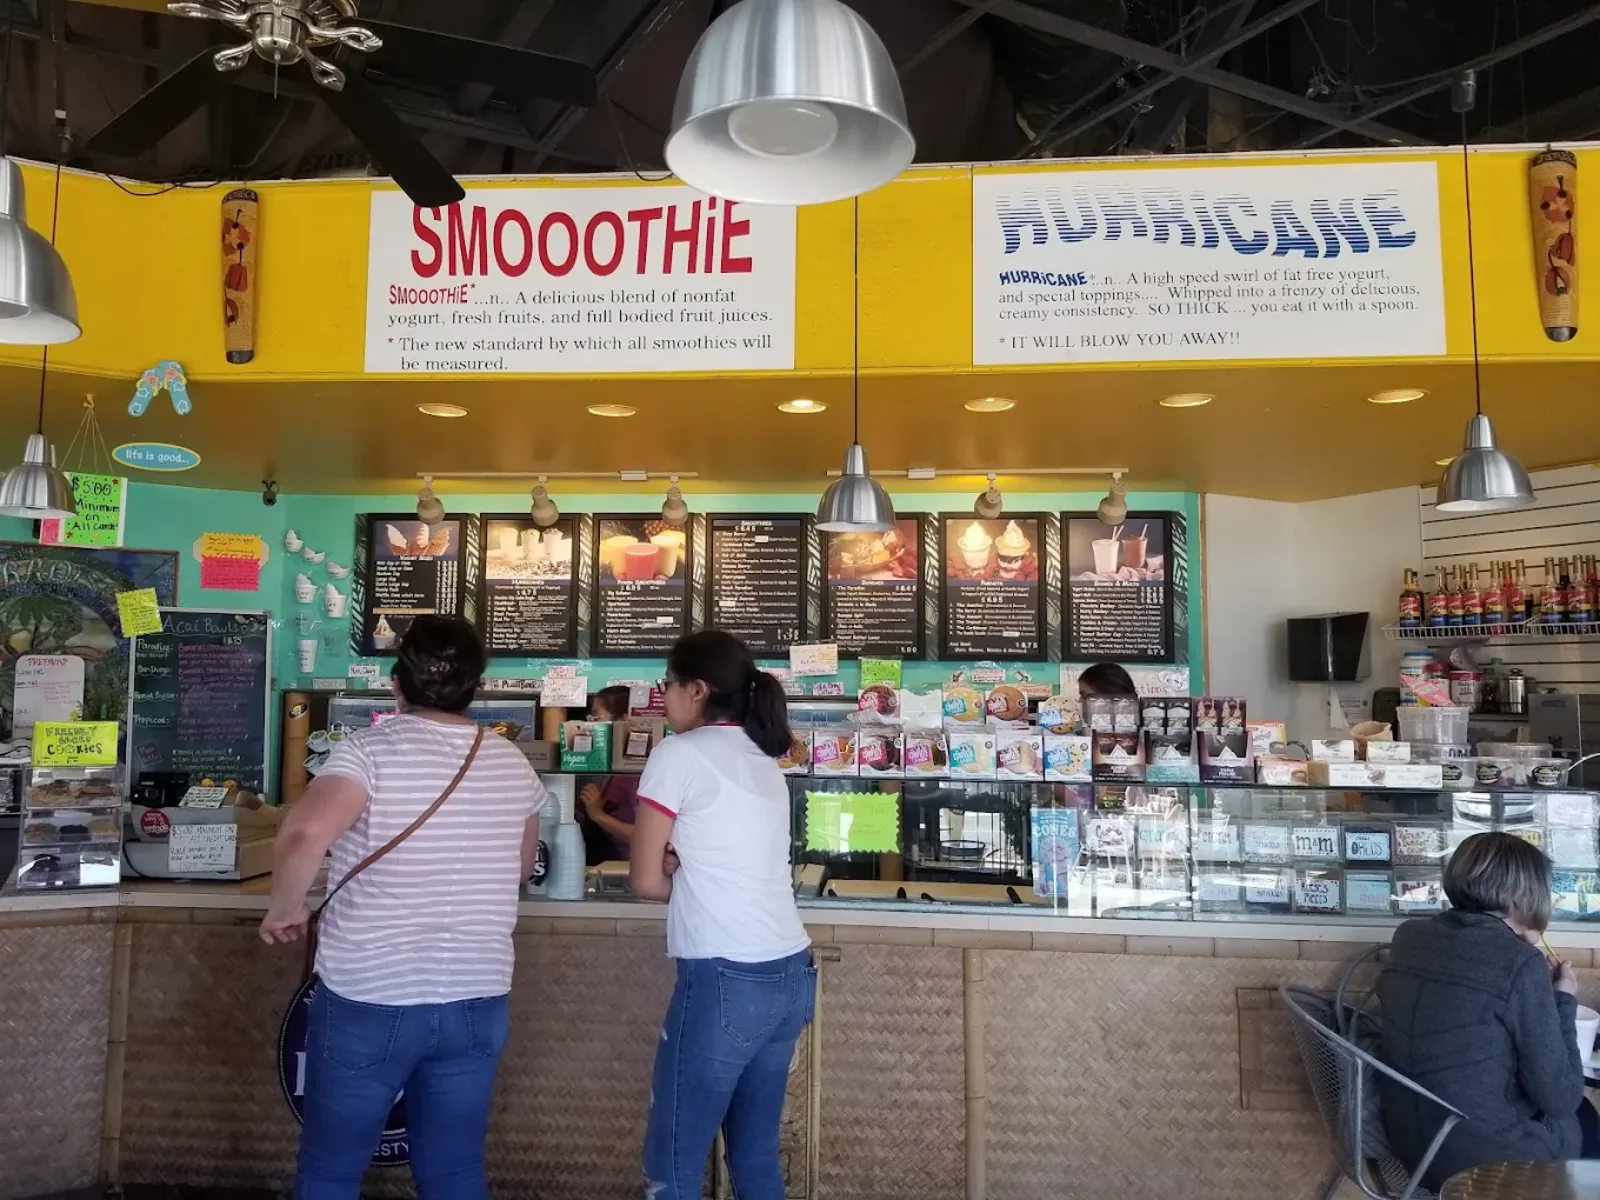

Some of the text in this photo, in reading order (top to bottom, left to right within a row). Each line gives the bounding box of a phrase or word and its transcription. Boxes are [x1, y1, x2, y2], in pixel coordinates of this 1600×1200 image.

[997, 183, 1416, 258] HURRICANE
[1127, 272, 1138, 284] A
[1143, 271, 1174, 287] high
[1179, 267, 1219, 287] speed
[1224, 269, 1259, 282] swirl
[1264, 268, 1279, 281] of
[1283, 268, 1301, 281] fat
[1307, 268, 1334, 280] free
[1339, 268, 1390, 284] yogurt,
[515, 291, 527, 304] A
[532, 291, 605, 304] delicious
[611, 289, 655, 303] blend
[661, 289, 678, 303] of
[683, 288, 736, 303] nonfat
[998, 291, 1024, 303] and
[1027, 289, 1076, 306] special
[1168, 286, 1232, 302] Whipped
[1237, 285, 1264, 298] into
[1268, 288, 1276, 297] a
[1281, 284, 1326, 301] frenzy
[1331, 283, 1348, 296] of
[1351, 282, 1420, 296] delicious,
[388, 308, 773, 328] yogurt, fresh fruits, and full bodied fruit juices.
[999, 308, 1050, 321] creamy
[1054, 304, 1138, 319] consistency.
[1148, 303, 1170, 315] SO
[1175, 301, 1229, 315] THICK
[1251, 304, 1278, 316] you
[1282, 302, 1302, 312] eat
[1308, 299, 1317, 312] it
[1322, 299, 1354, 311] with
[1358, 303, 1367, 311] a
[1371, 300, 1419, 313] spoon.
[400, 337, 430, 351] The
[435, 341, 467, 350] new
[472, 337, 543, 351] standard
[549, 336, 568, 353] by
[574, 336, 622, 350] which
[628, 336, 647, 350] all
[652, 336, 738, 349] smoothies
[742, 335, 772, 349] will
[1011, 336, 1028, 348] IT
[1033, 336, 1075, 348] WILL
[1080, 335, 1130, 347] BLOW
[1136, 333, 1175, 346] YOU
[1179, 332, 1240, 345] AWAY!!
[401, 356, 508, 370] be measured.
[126, 449, 143, 460] life
[146, 452, 154, 460] is
[85, 513, 100, 522] on
[563, 753, 586, 768] Vegan
